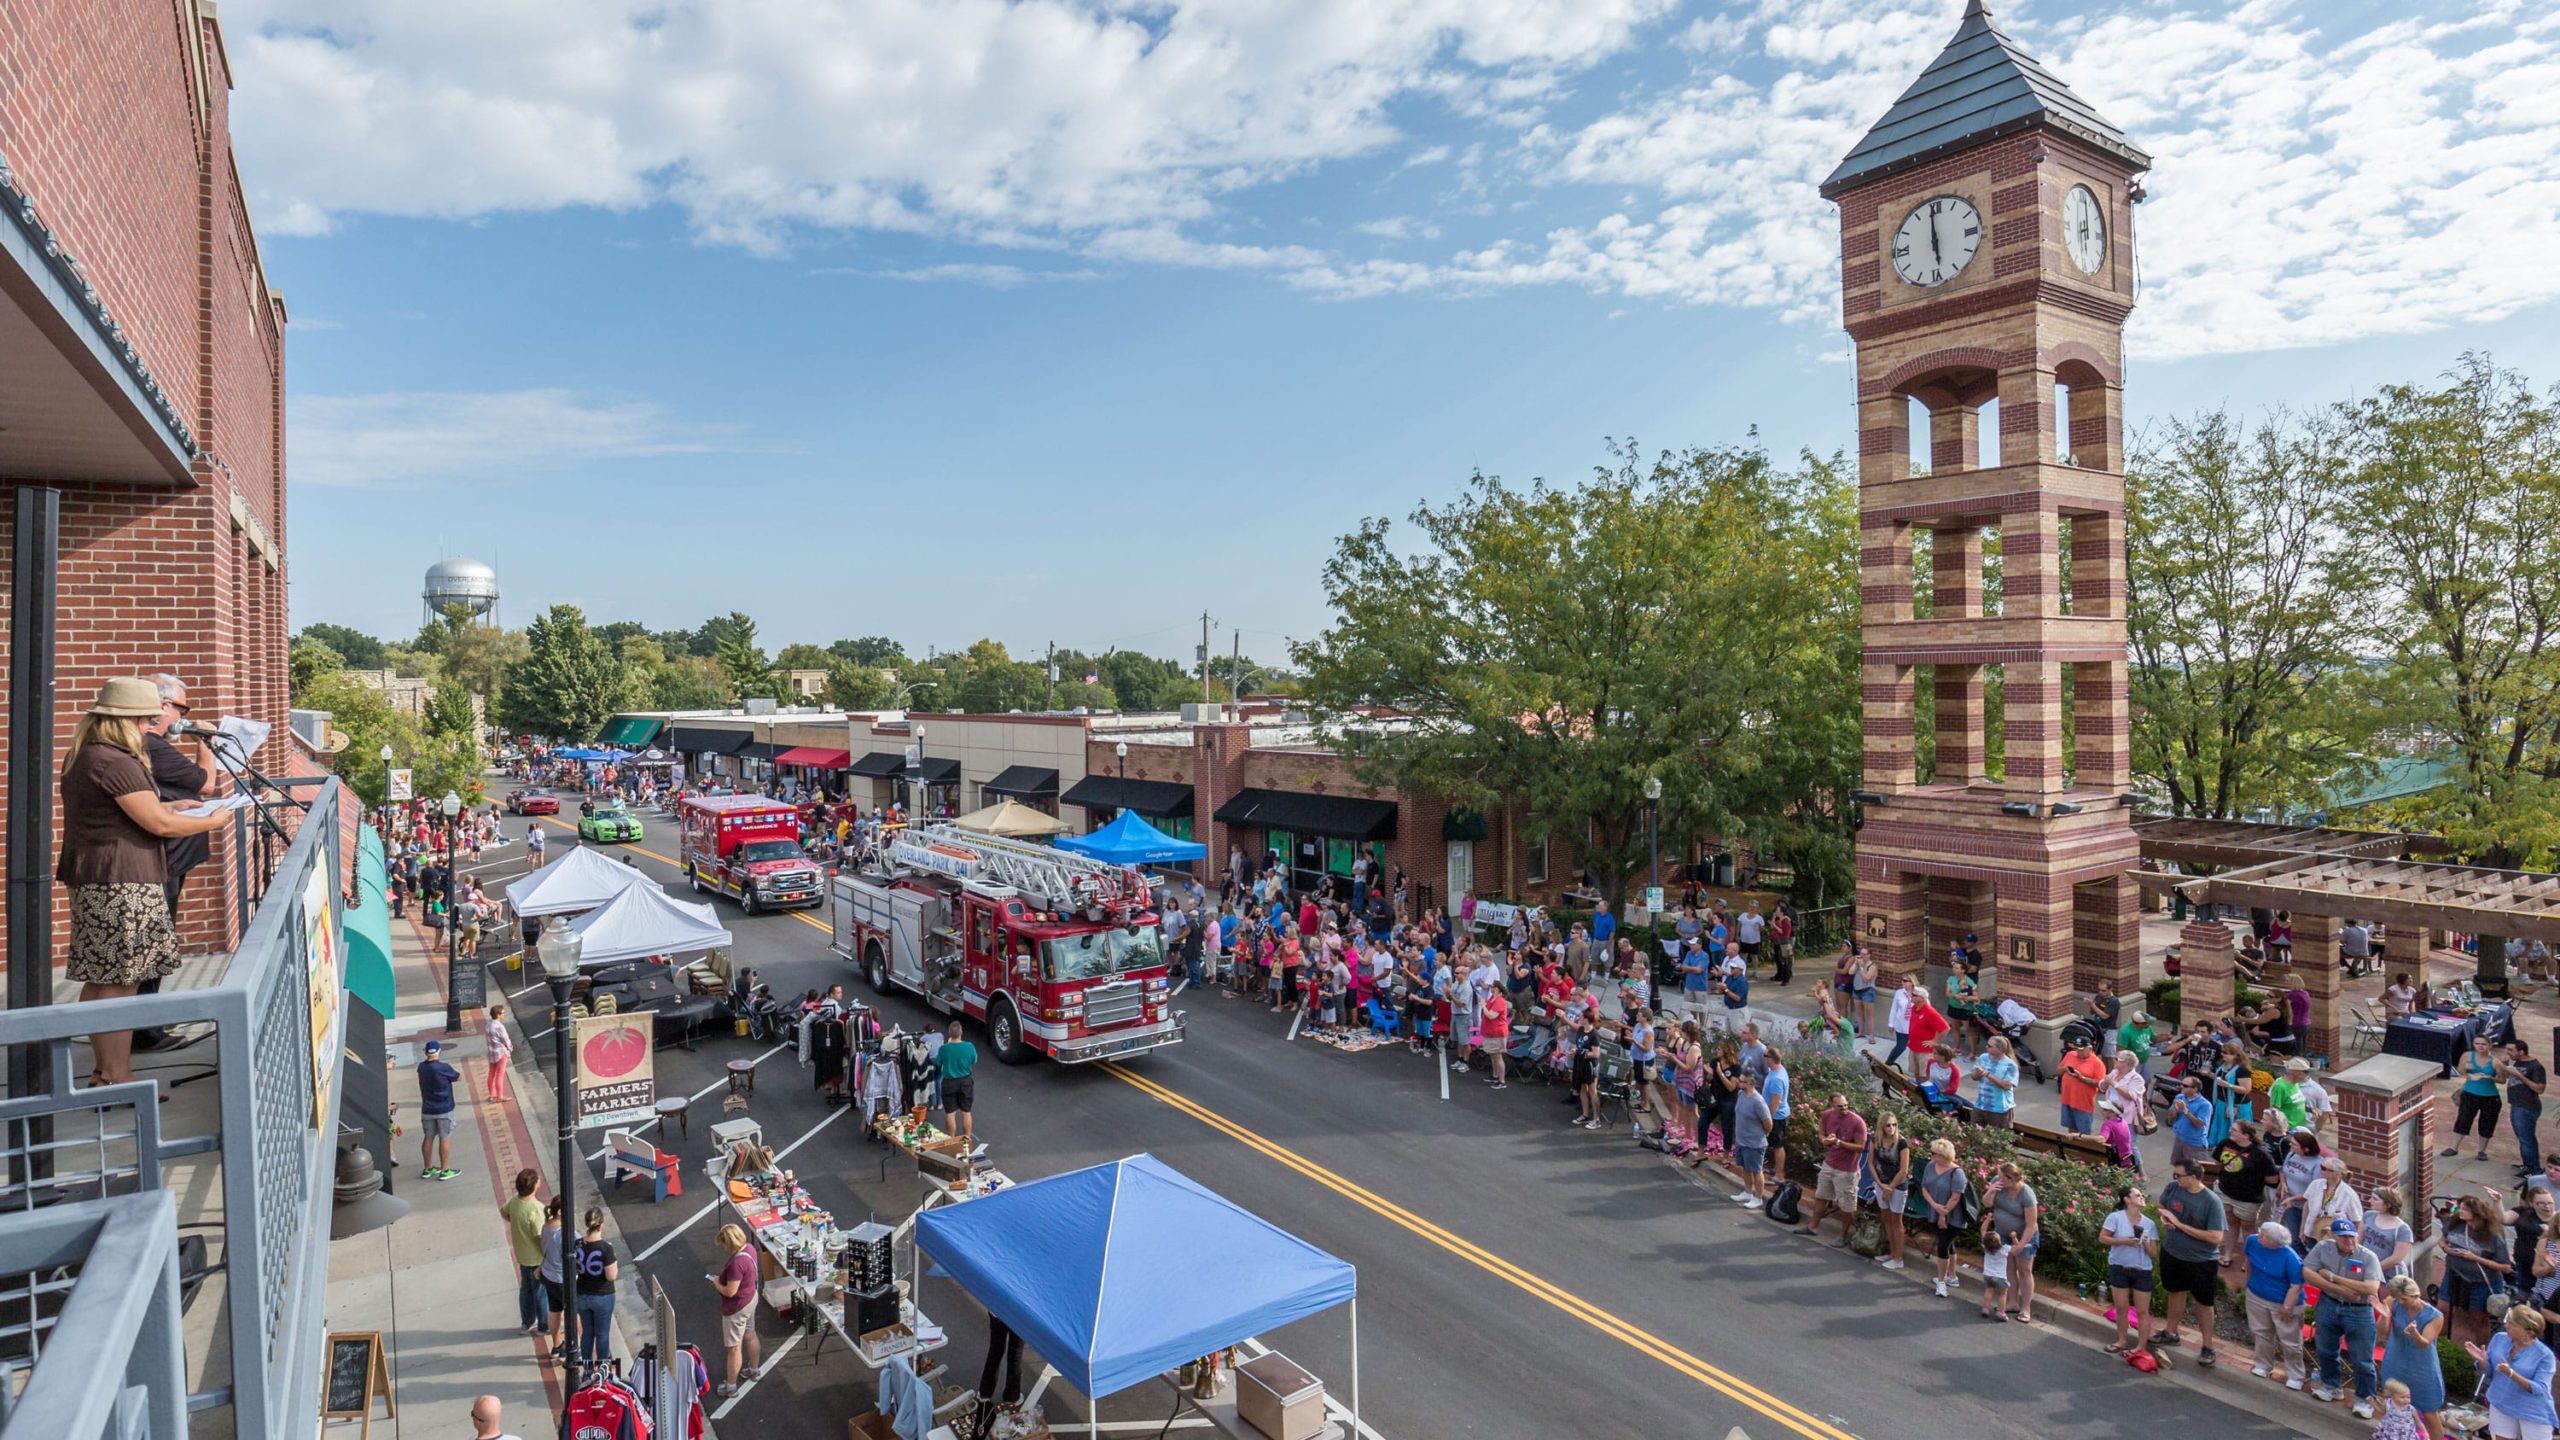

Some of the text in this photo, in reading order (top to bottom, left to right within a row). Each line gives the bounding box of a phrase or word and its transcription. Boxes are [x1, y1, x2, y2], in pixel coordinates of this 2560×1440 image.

[899, 845, 929, 866] OVERLAND
[932, 853, 950, 872] PARK
[1102, 973, 1125, 983] OPFD
[1020, 991, 1040, 1006] OPFD
[580, 1080, 654, 1101] FARMERS'
[584, 1094, 649, 1113] MARKET
[606, 1110, 639, 1120] Downtown
[579, 1428, 590, 1439] DU
